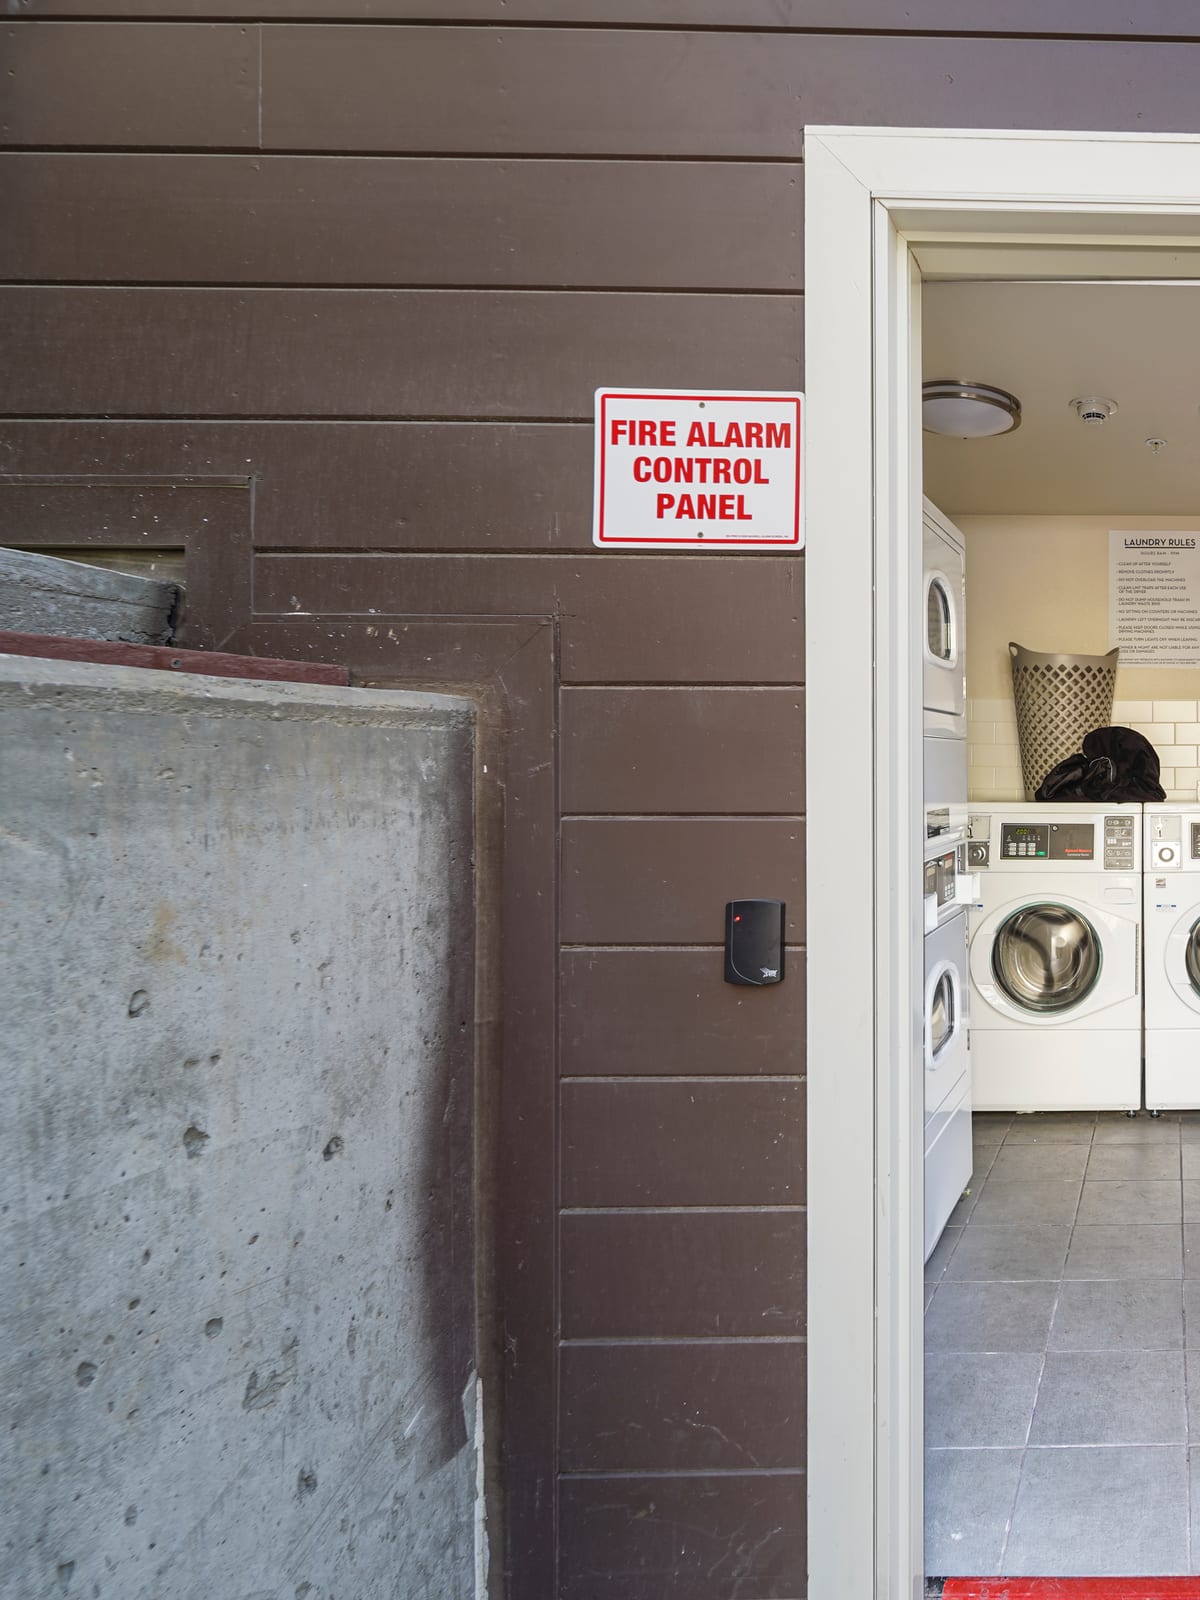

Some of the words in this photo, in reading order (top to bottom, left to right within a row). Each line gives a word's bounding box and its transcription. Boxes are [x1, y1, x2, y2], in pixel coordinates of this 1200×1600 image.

[611, 420, 676, 446] FIRE
[686, 422, 791, 448] ALARM
[633, 456, 769, 484] CONTROL
[656, 494, 752, 520] PANEL
[1124, 538, 1166, 546] LAUNDRY
[1168, 538, 1196, 546] RULES
